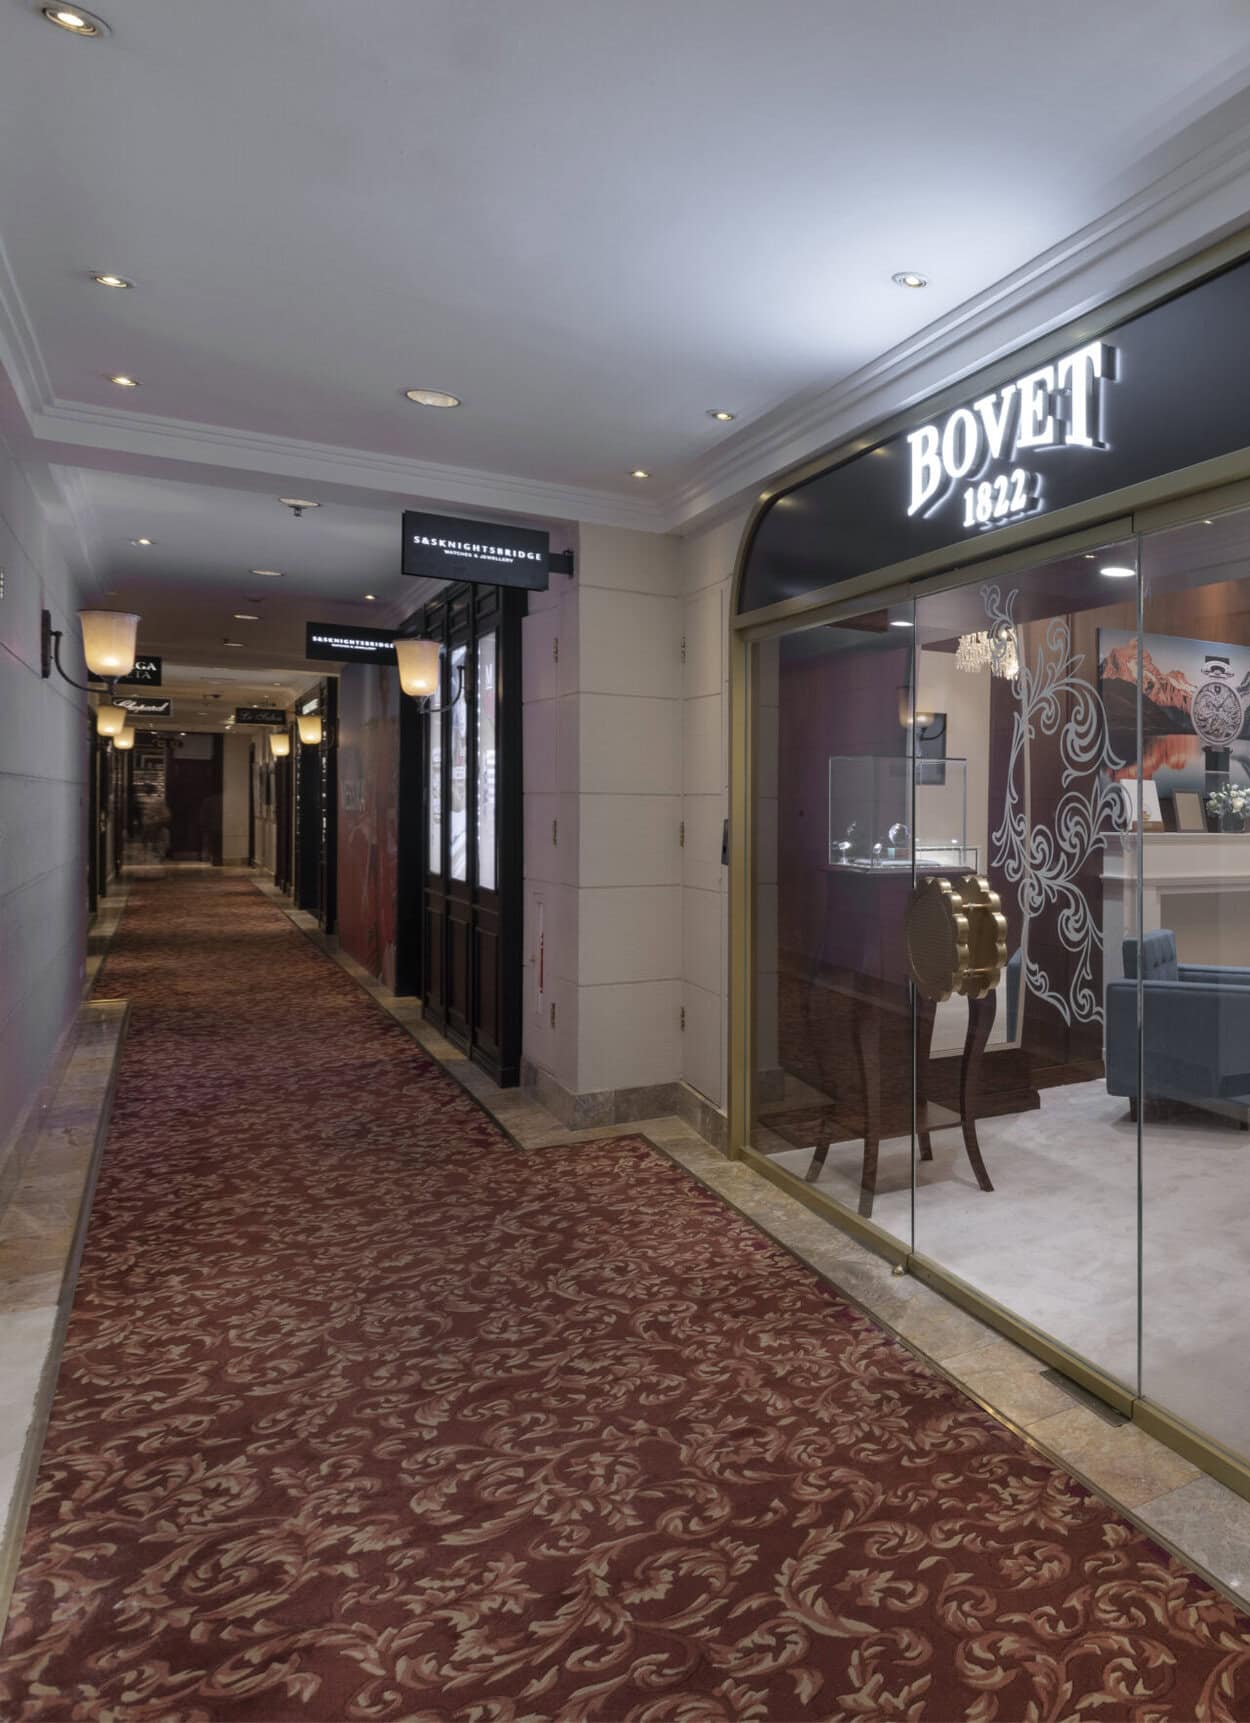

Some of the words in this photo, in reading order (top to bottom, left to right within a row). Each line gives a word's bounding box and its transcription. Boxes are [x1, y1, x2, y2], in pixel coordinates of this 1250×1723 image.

[907, 341, 1106, 517] BOVET
[963, 469, 1028, 527] 1822
[413, 535, 542, 561] S&SKNIGHTSBRIDGE
